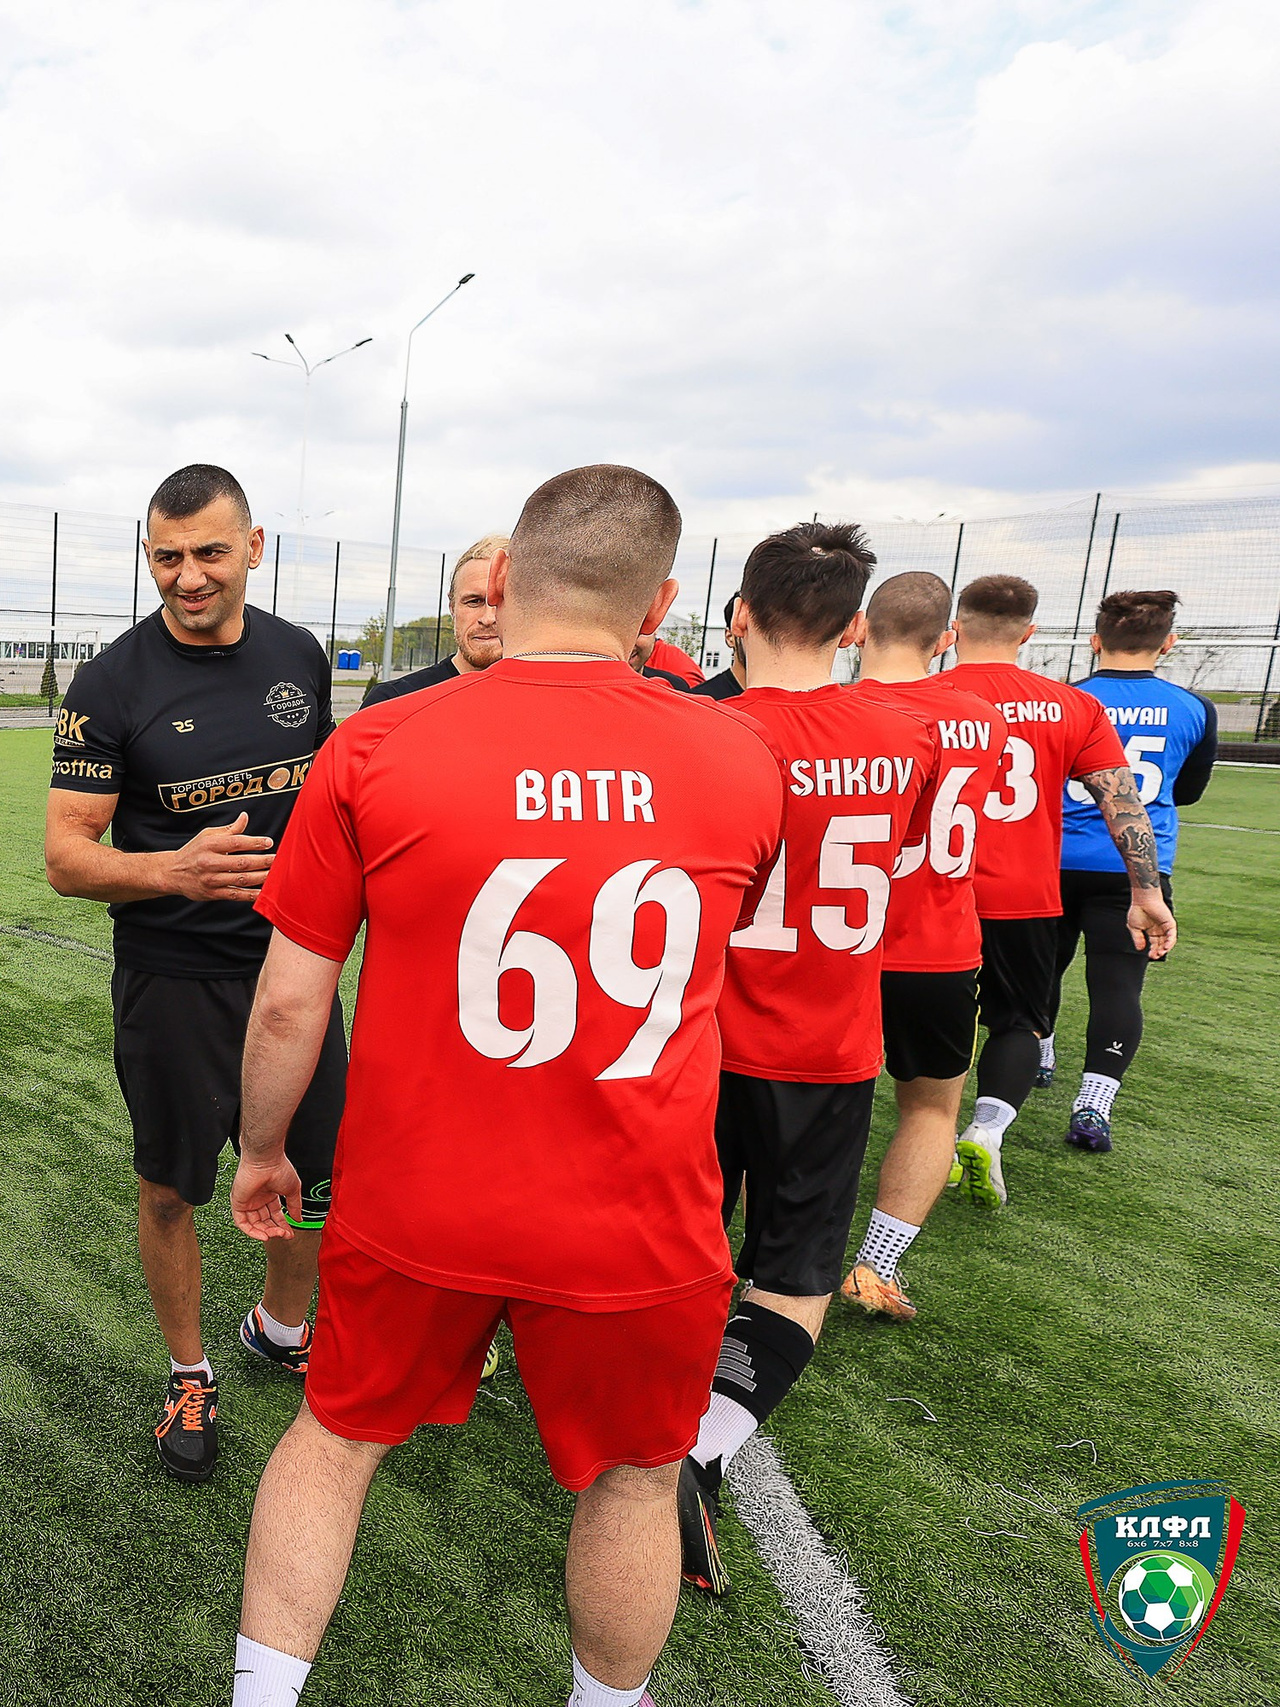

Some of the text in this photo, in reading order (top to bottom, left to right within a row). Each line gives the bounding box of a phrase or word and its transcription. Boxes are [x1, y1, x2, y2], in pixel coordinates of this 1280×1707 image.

[171, 771, 253, 794] ТОРГОВАЯ СЕТЬ
[515, 768, 656, 823] BATR
[783, 755, 916, 798] SHKOV
[457, 857, 702, 1082] 69
